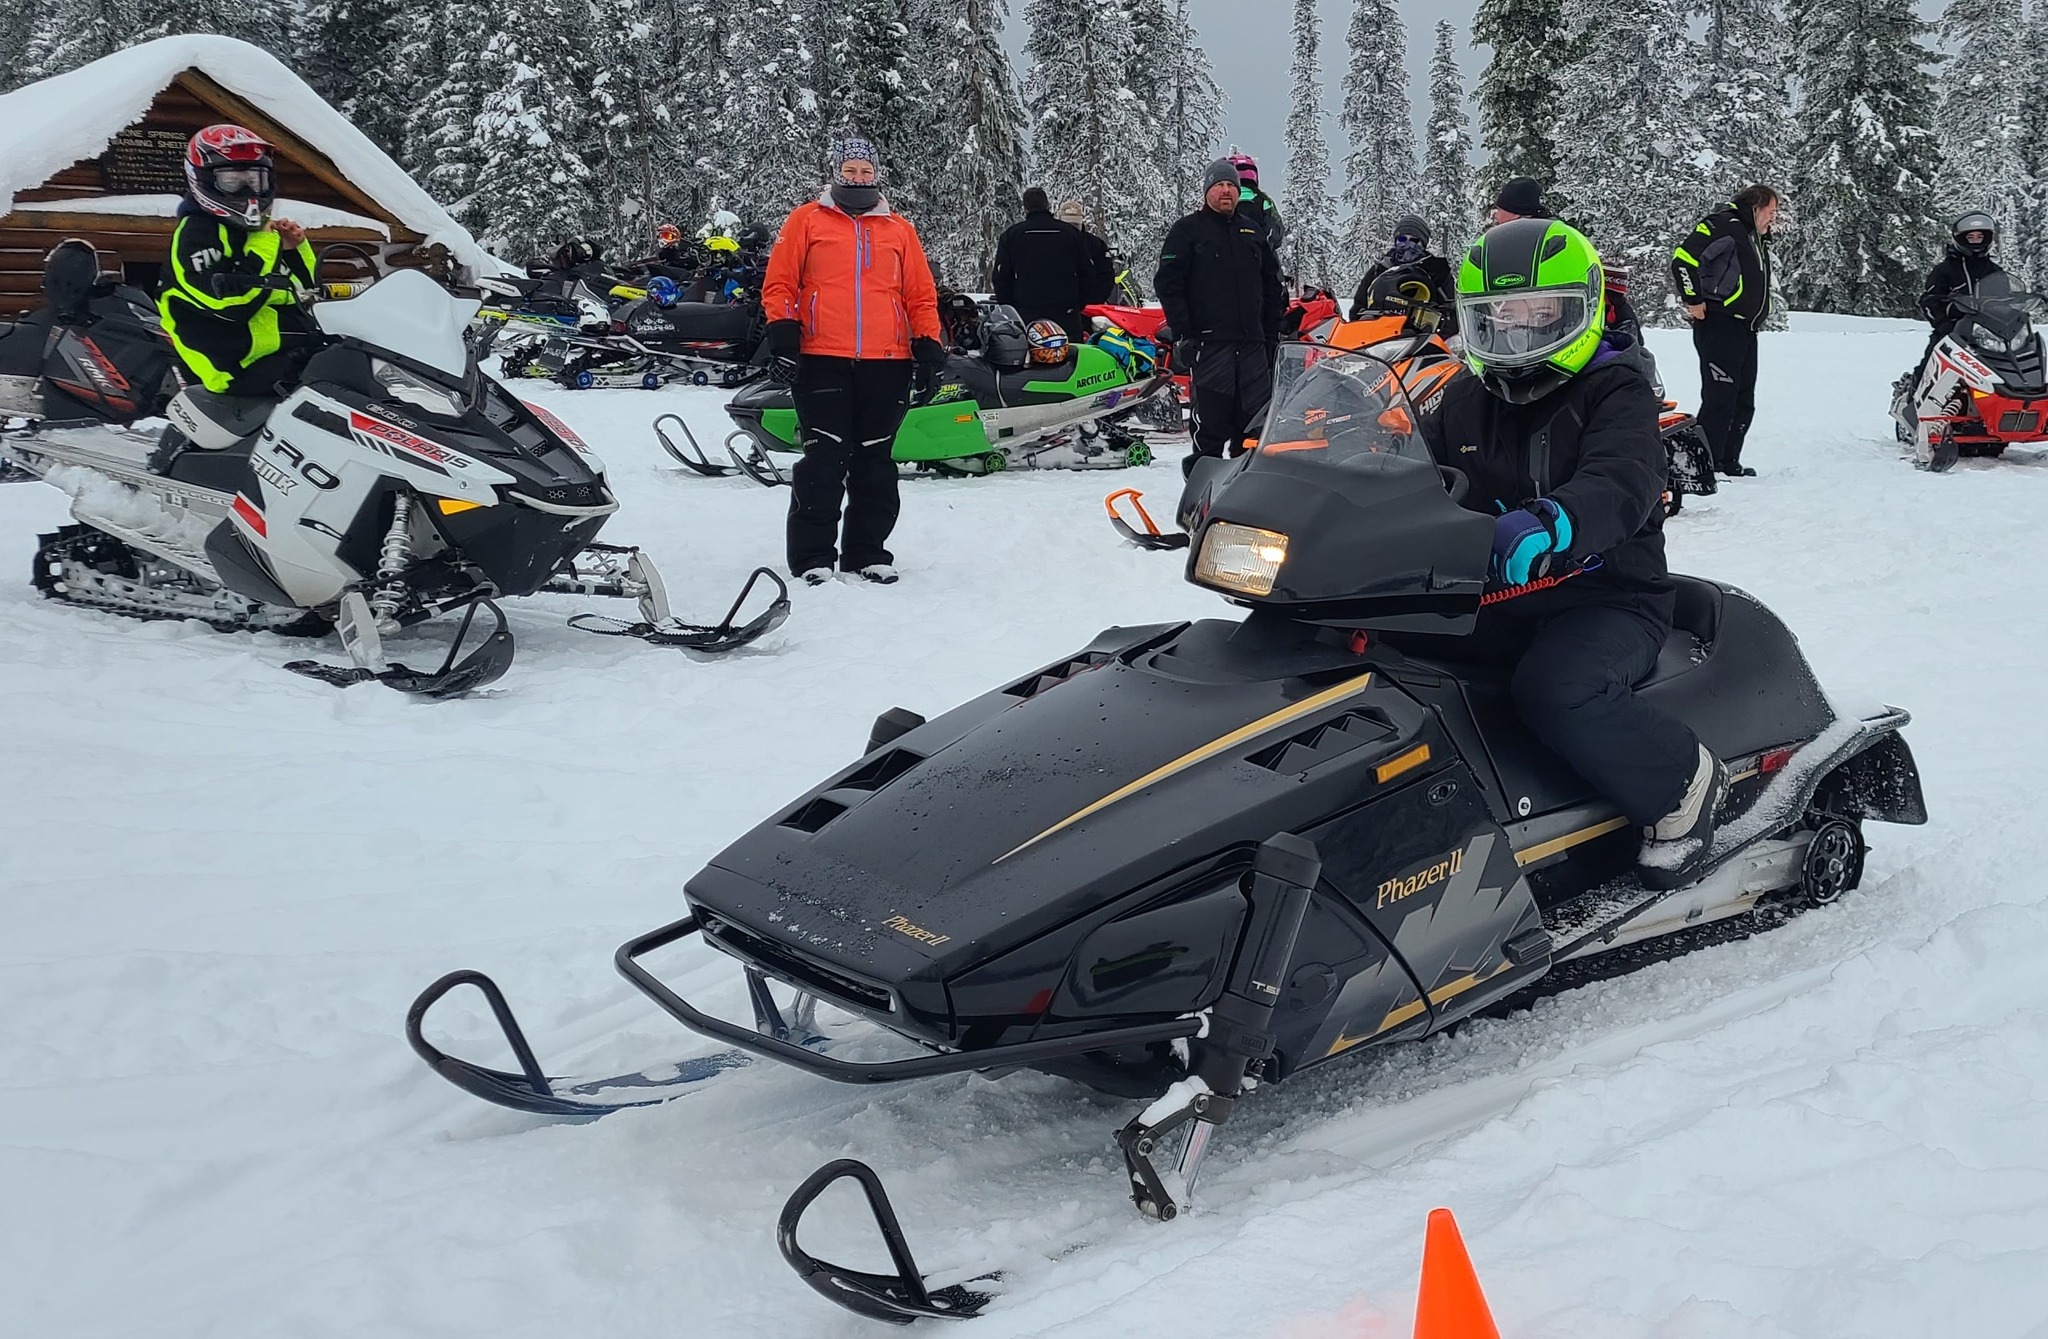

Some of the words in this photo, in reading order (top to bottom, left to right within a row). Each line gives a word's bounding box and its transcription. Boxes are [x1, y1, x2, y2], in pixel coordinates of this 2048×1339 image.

[147, 130, 187, 140] SPRINGS
[157, 140, 189, 149] SHELTE
[636, 322, 676, 333] POLARIS
[78, 357, 113, 389] RMK
[1076, 374, 1101, 388] ARCTIC
[1103, 370, 1116, 381] CAT
[369, 423, 473, 469] POLARIS
[262, 427, 342, 492] PRO
